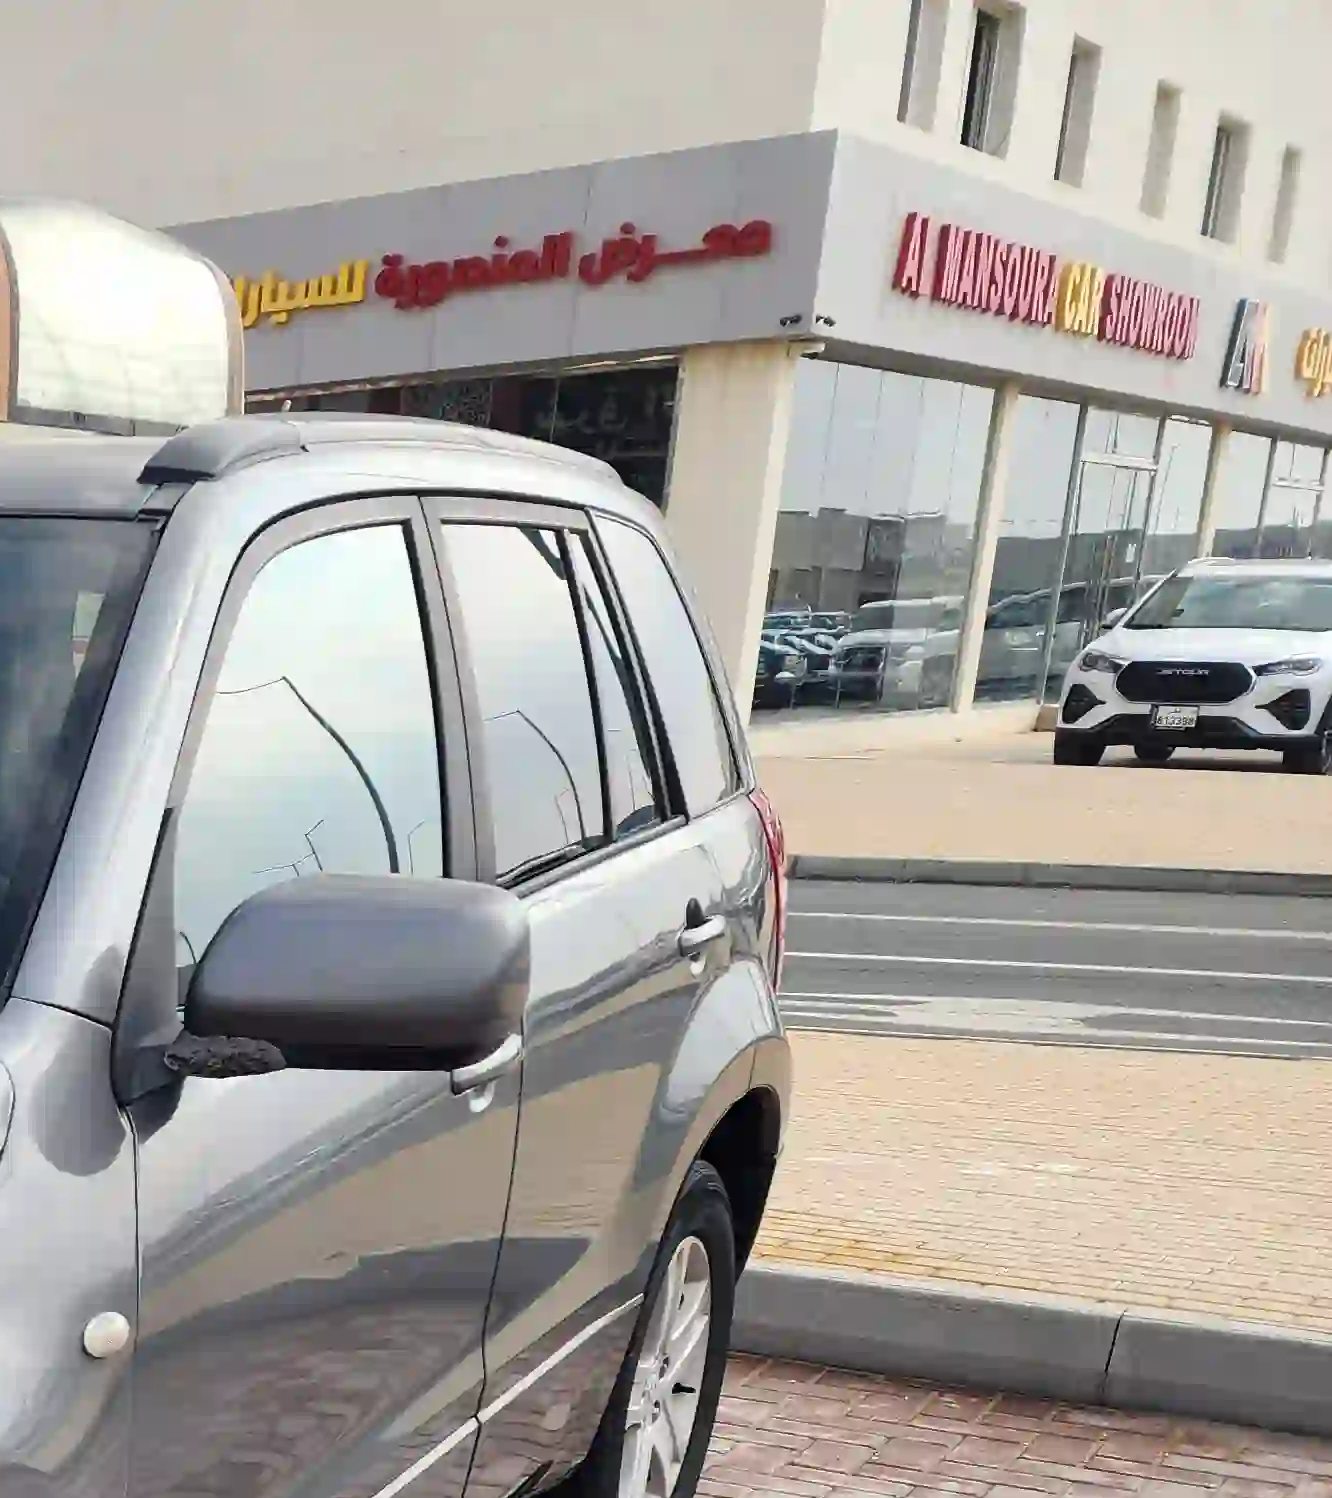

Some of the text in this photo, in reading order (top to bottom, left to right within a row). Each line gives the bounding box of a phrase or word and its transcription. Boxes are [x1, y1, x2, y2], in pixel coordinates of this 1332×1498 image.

[235, 220, 772, 328] معرض المنصورة للسيارا
[892, 211, 1200, 361] AL MANSOURA CAR SHOWROOM
